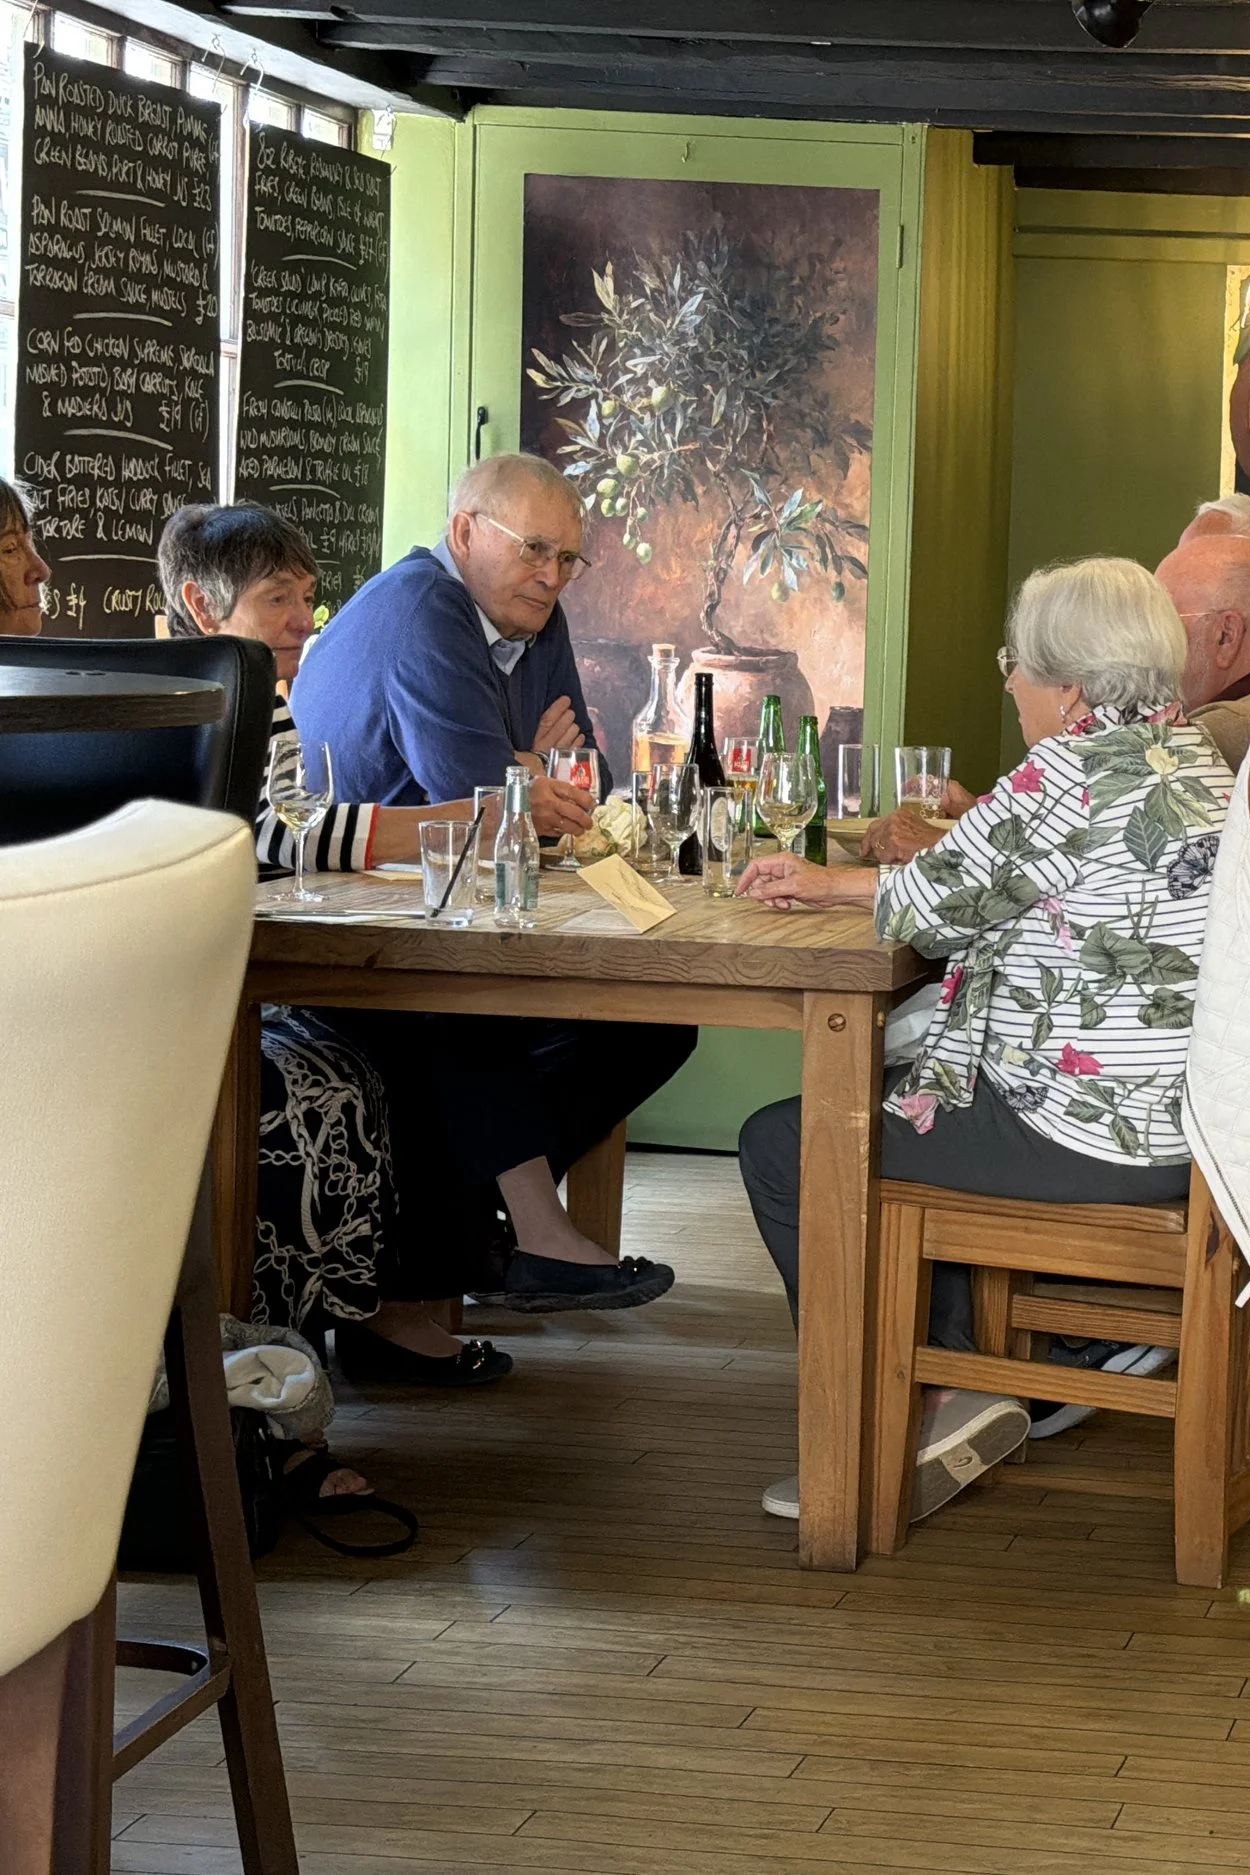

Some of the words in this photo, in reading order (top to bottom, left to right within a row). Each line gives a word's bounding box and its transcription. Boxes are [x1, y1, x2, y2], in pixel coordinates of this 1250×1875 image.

[33, 62, 56, 99] PAN
[58, 73, 104, 112] ROASTED
[107, 90, 135, 117] DUCK
[71, 111, 102, 142] HONEY
[105, 119, 144, 151] ROASTED
[147, 133, 178, 160] CARROT
[33, 137, 71, 169] GREEN
[112, 155, 137, 184] PORT
[134, 160, 146, 193] &
[146, 166, 171, 195] HONEY
[192, 177, 212, 212] £23
[31, 194, 56, 226] PAN
[60, 200, 92, 232] ROAST
[97, 208, 136, 244] SALMON
[164, 258, 201, 287] MUSTARD
[201, 263, 209, 291] &
[25, 262, 78, 293] TARRAGON
[82, 271, 116, 296] CREAM
[195, 289, 218, 325] £20
[26, 327, 60, 357] CORN
[64, 326, 82, 356] FED
[85, 333, 129, 361] CHICKEN
[26, 363, 68, 388] MASHED
[113, 366, 138, 394] BABY
[184, 376, 204, 403] KALE
[42, 391, 53, 418] &
[111, 397, 134, 427] JUS
[158, 400, 182, 433] £19
[243, 391, 268, 420] FRESH
[240, 428, 258, 451] WILD
[23, 451, 62, 482] CIDER
[65, 453, 116, 482] BATTERED
[121, 453, 162, 483] HADDOCK
[197, 462, 212, 491] SEA
[239, 455, 260, 479] AGED
[261, 454, 302, 481] PARMESAN
[305, 457, 313, 481] &
[129, 488, 158, 516] CURRY
[96, 512, 108, 541] &
[112, 520, 154, 545] LEMON
[320, 527, 336, 554] £9
[321, 571, 342, 596] FRIES
[66, 582, 87, 630] £4
[103, 587, 143, 617] CRUSTY
